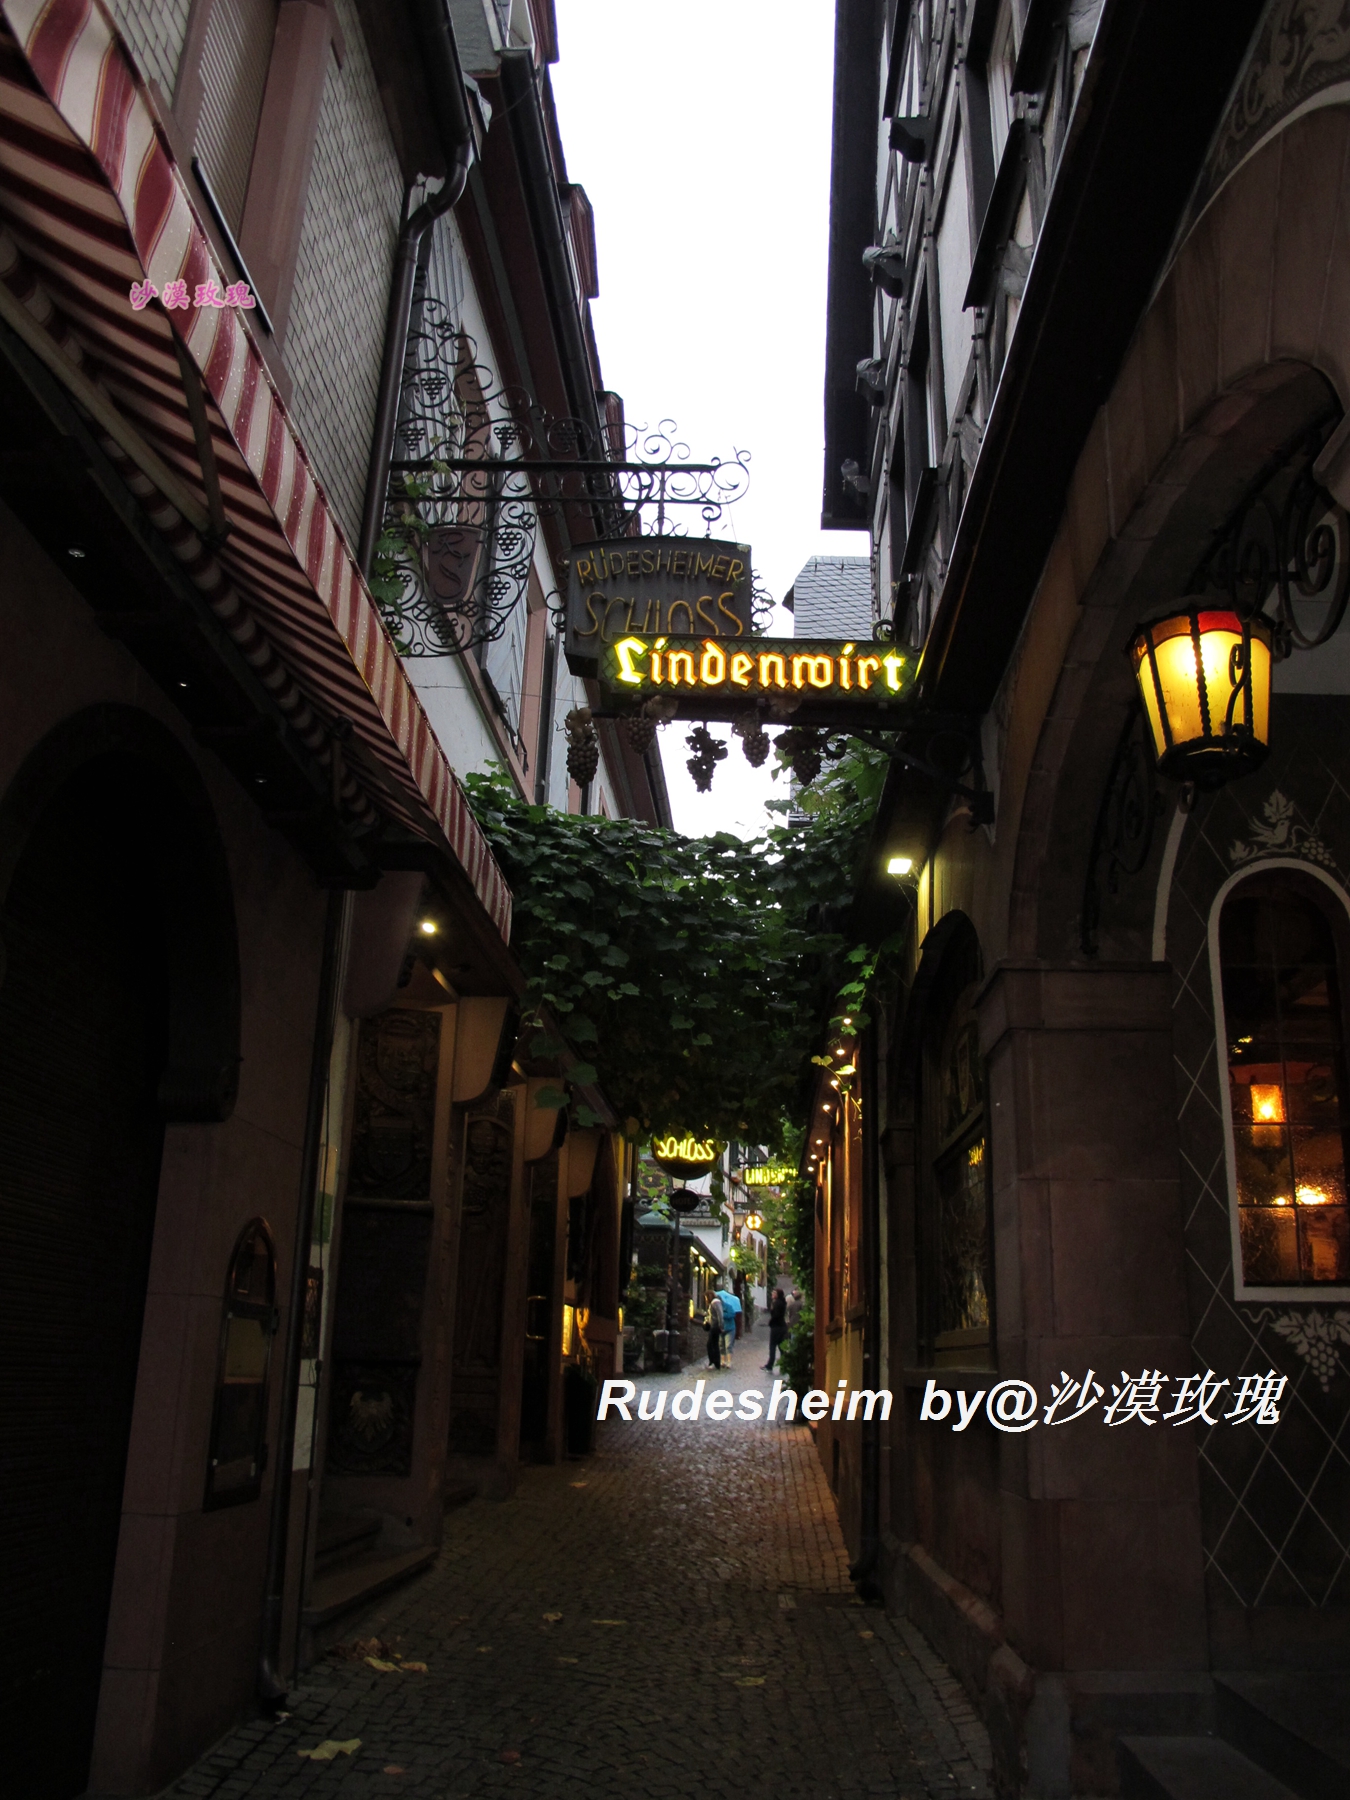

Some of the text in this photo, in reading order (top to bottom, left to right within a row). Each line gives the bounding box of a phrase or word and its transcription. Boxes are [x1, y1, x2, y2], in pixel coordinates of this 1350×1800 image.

[576, 547, 745, 587] RÜDESHEIMER
[573, 591, 743, 643] SCHLOSS
[614, 635, 906, 693] Lindenwirt
[657, 1136, 715, 1161] SCHLOSS
